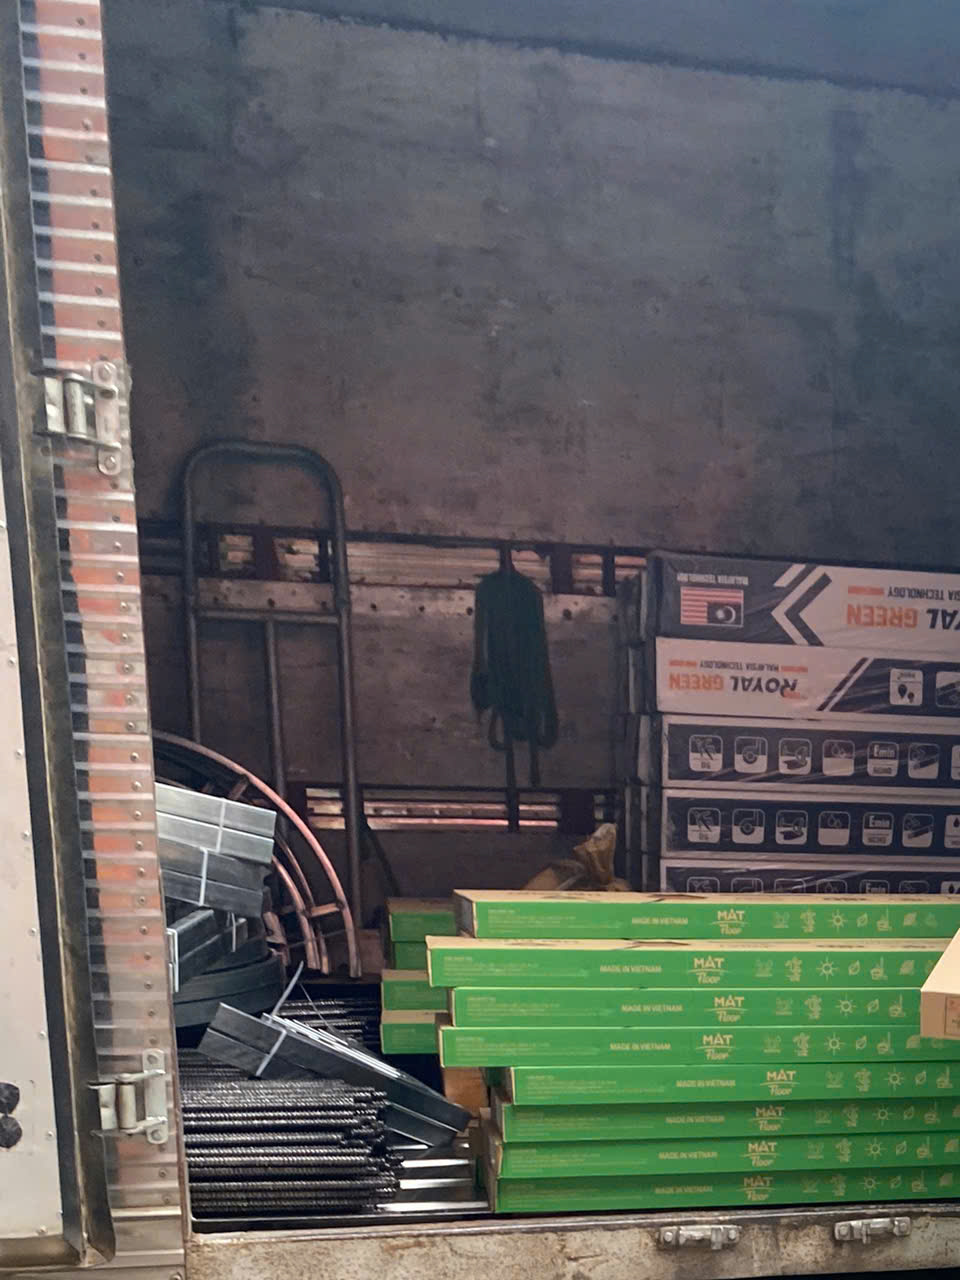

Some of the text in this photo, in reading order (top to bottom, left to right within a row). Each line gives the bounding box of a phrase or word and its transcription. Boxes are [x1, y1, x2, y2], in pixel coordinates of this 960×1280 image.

[887, 586, 945, 600] TECHNOLOGY
[847, 603, 918, 629] GREEN
[669, 671, 807, 700] ROYAL GREEN
